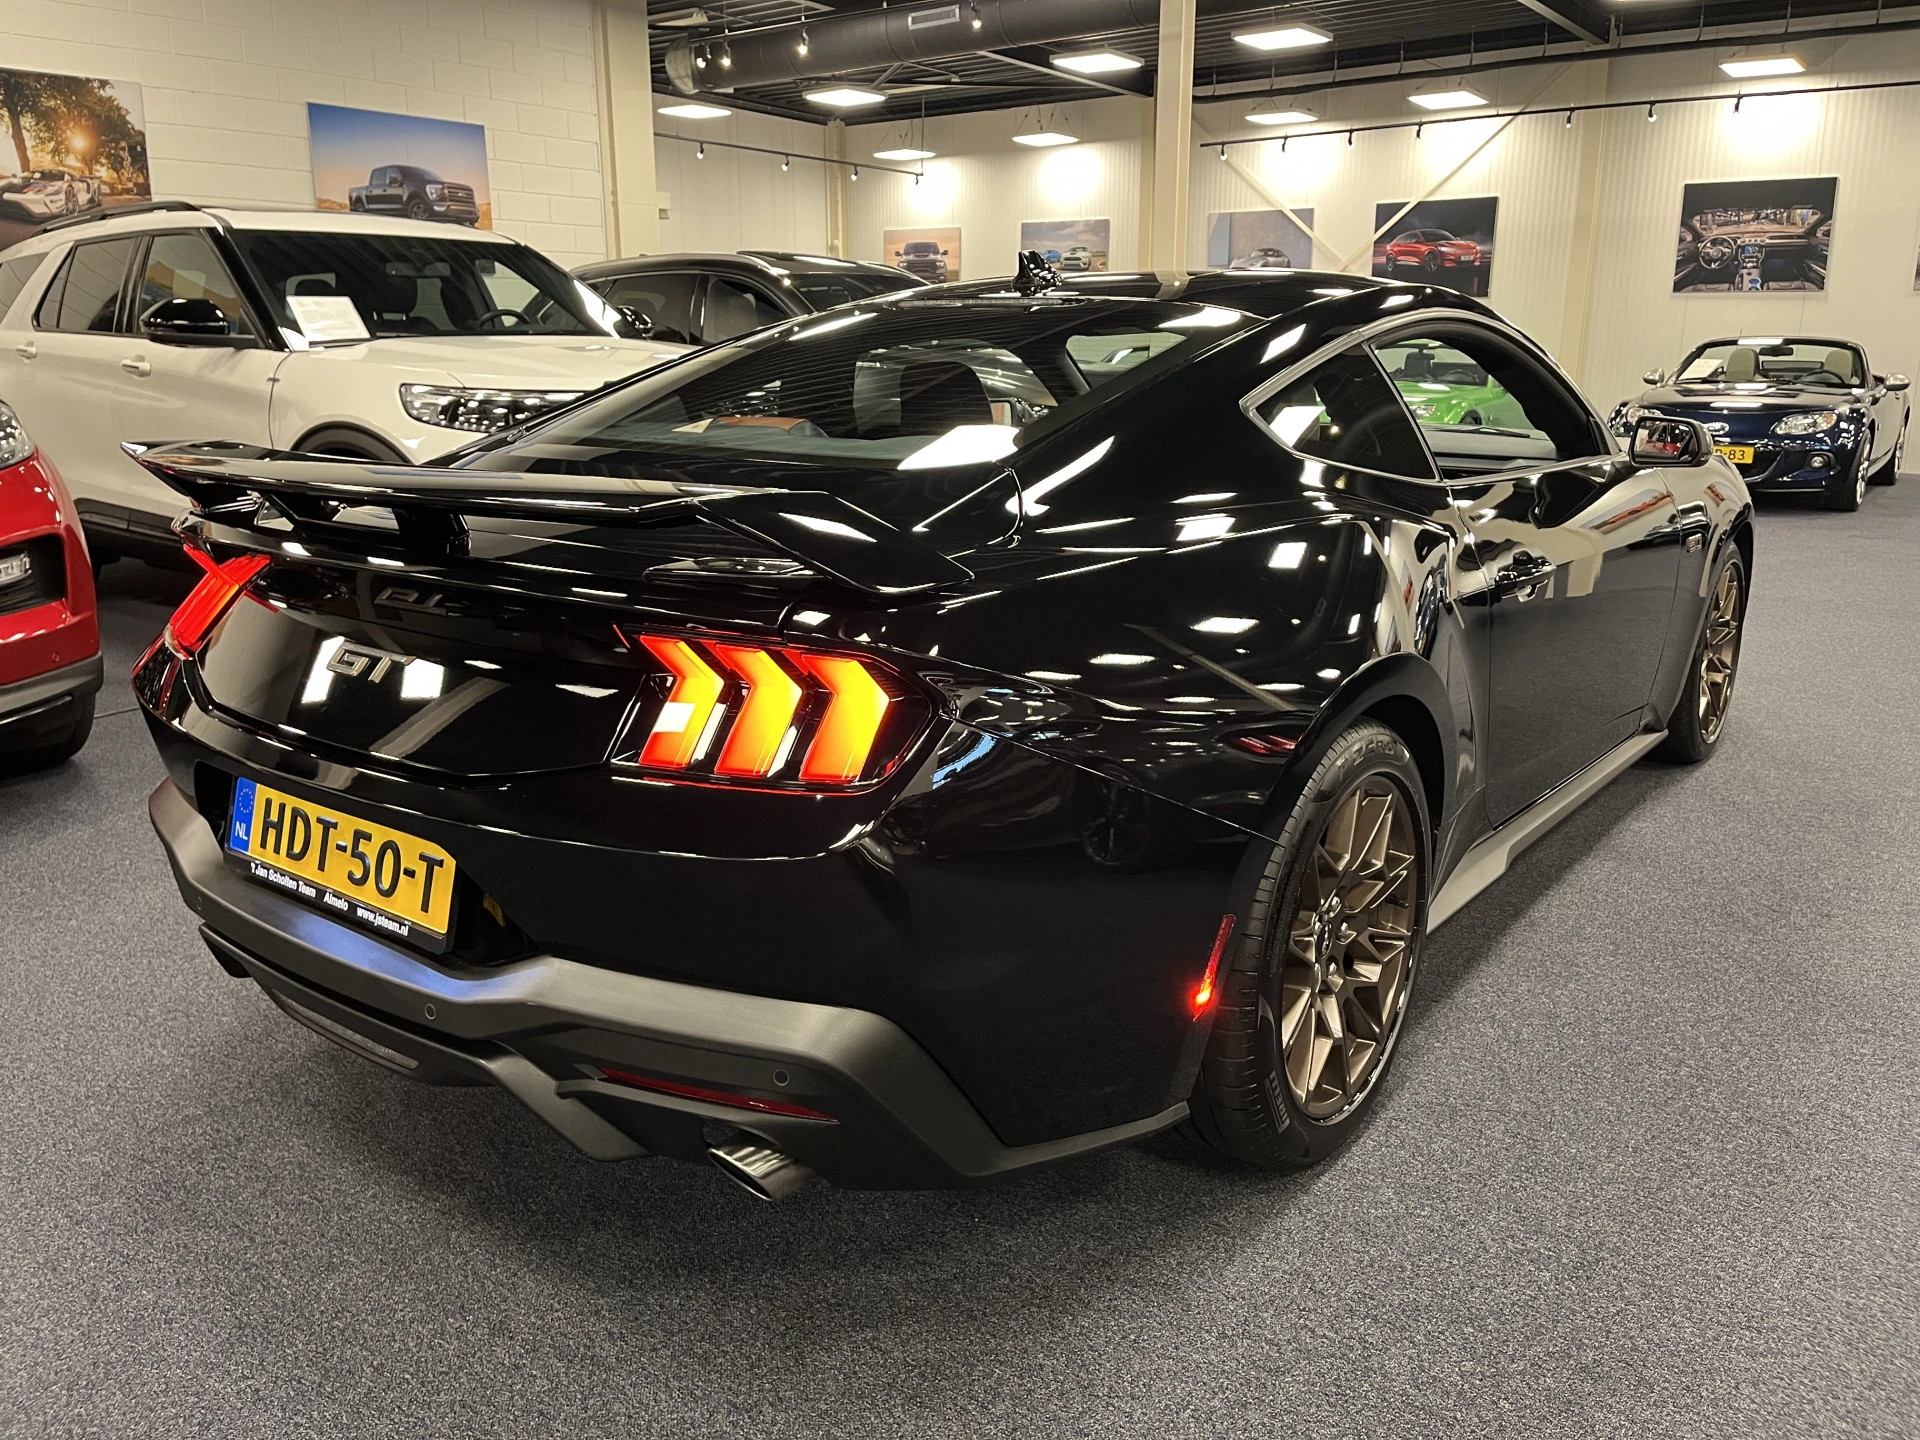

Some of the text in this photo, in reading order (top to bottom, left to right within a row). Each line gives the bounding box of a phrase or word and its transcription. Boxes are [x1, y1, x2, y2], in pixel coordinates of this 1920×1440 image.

[326, 639, 416, 684] GT
[235, 821, 249, 840] NL
[259, 797, 444, 914] HDT-50-T
[255, 864, 268, 878] Jan
[298, 880, 316, 898] Team
[323, 891, 349, 911] Almelo
[356, 905, 409, 936] www.jsteam.nl
